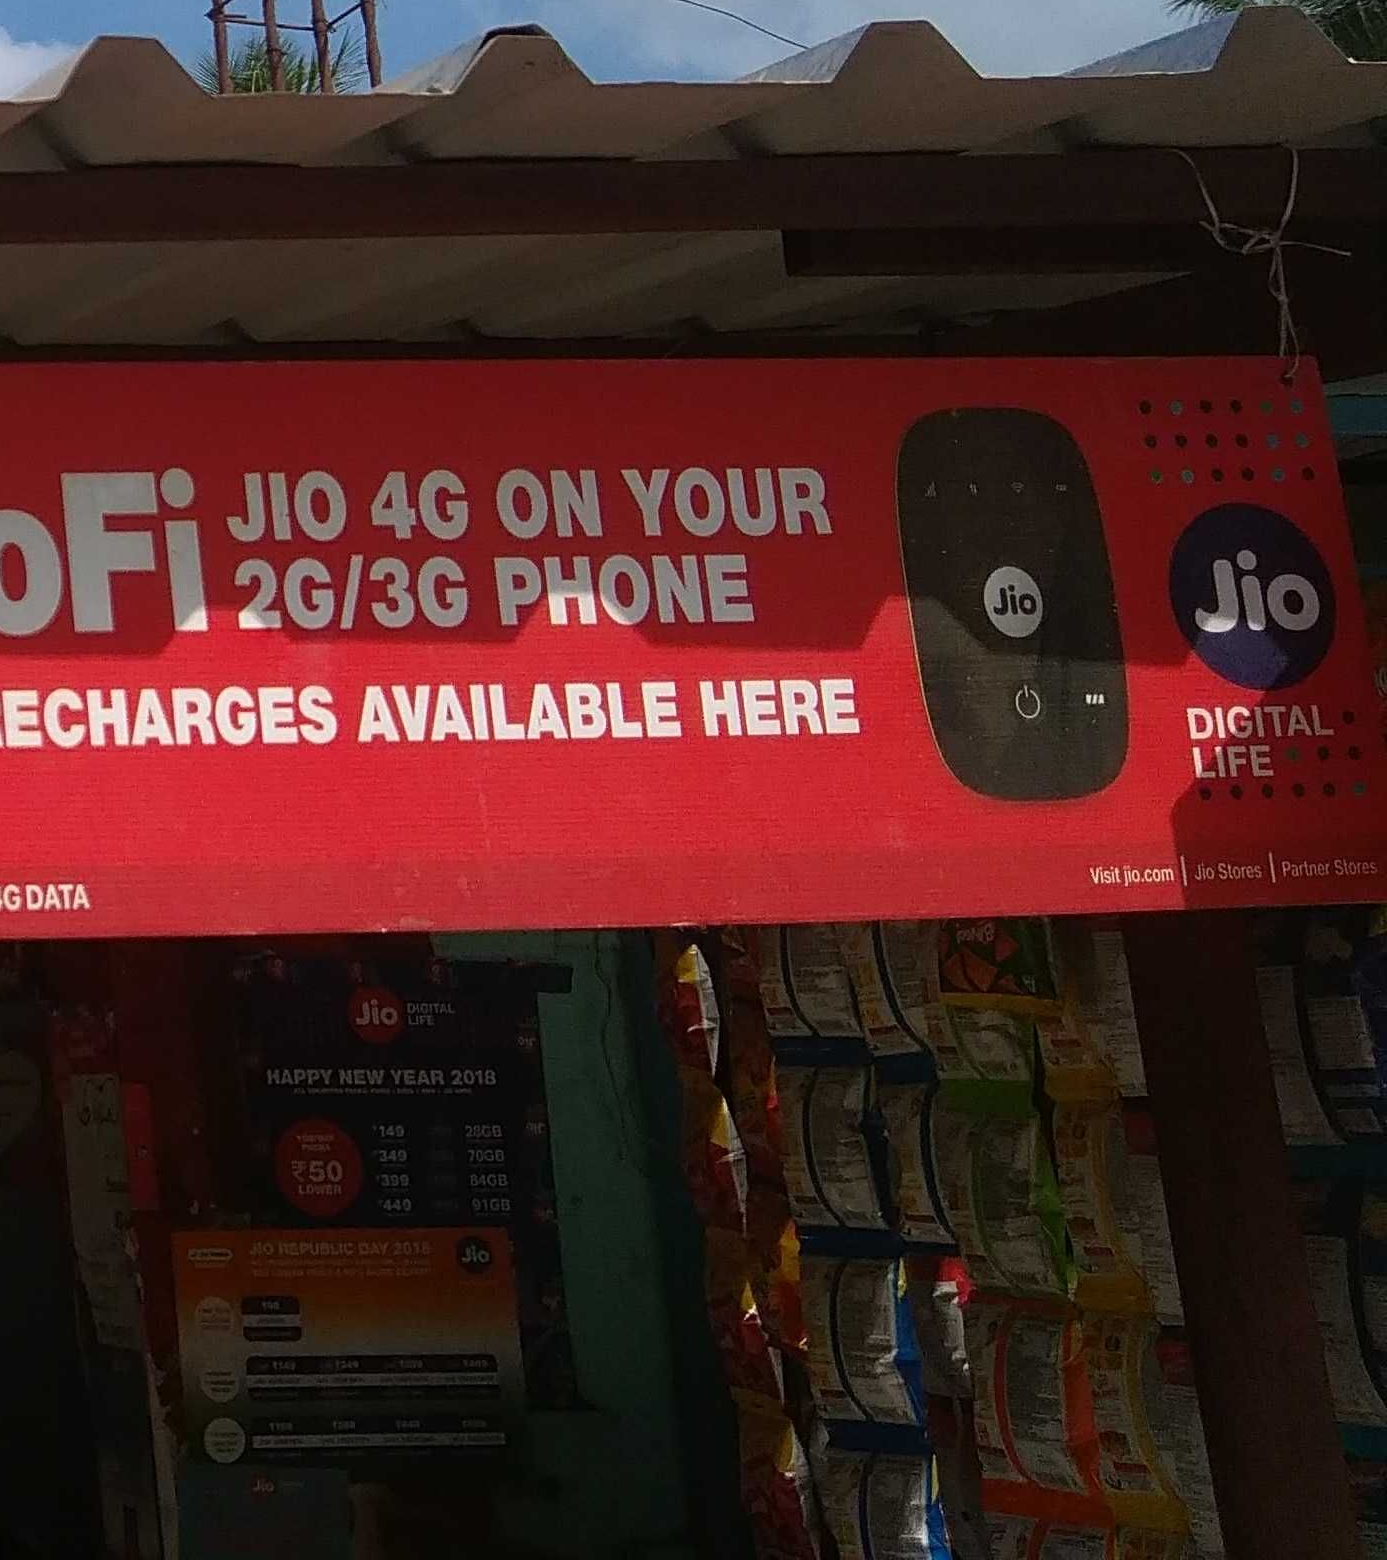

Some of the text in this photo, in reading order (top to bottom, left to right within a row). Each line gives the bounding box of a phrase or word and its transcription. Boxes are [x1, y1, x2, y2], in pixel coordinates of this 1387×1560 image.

[226, 466, 833, 542] JIO 4G ON YOUR
[233, 553, 756, 631] 2G/3G PHONE
[993, 581, 1038, 617] Jio
[1194, 550, 1322, 633] Jio
[357, 680, 682, 742] AVAILABLE
[698, 677, 861, 738] HERE
[1186, 704, 1335, 743] DIGITAL
[1191, 743, 1276, 780] LIFE
[1089, 866, 1175, 888] Visit jio.com
[1194, 862, 1263, 881] Jio Stores
[1282, 858, 1379, 878] Partner Stores
[26, 883, 91, 911] DATA
[354, 999, 399, 1027] Jio
[406, 1001, 456, 1016] DIGITAL
[407, 1014, 435, 1027] LIFE
[266, 1068, 333, 1086] HAPPY
[338, 1068, 387, 1086] NEW
[389, 1068, 446, 1086] YEAR
[460, 1245, 491, 1264] Jio
